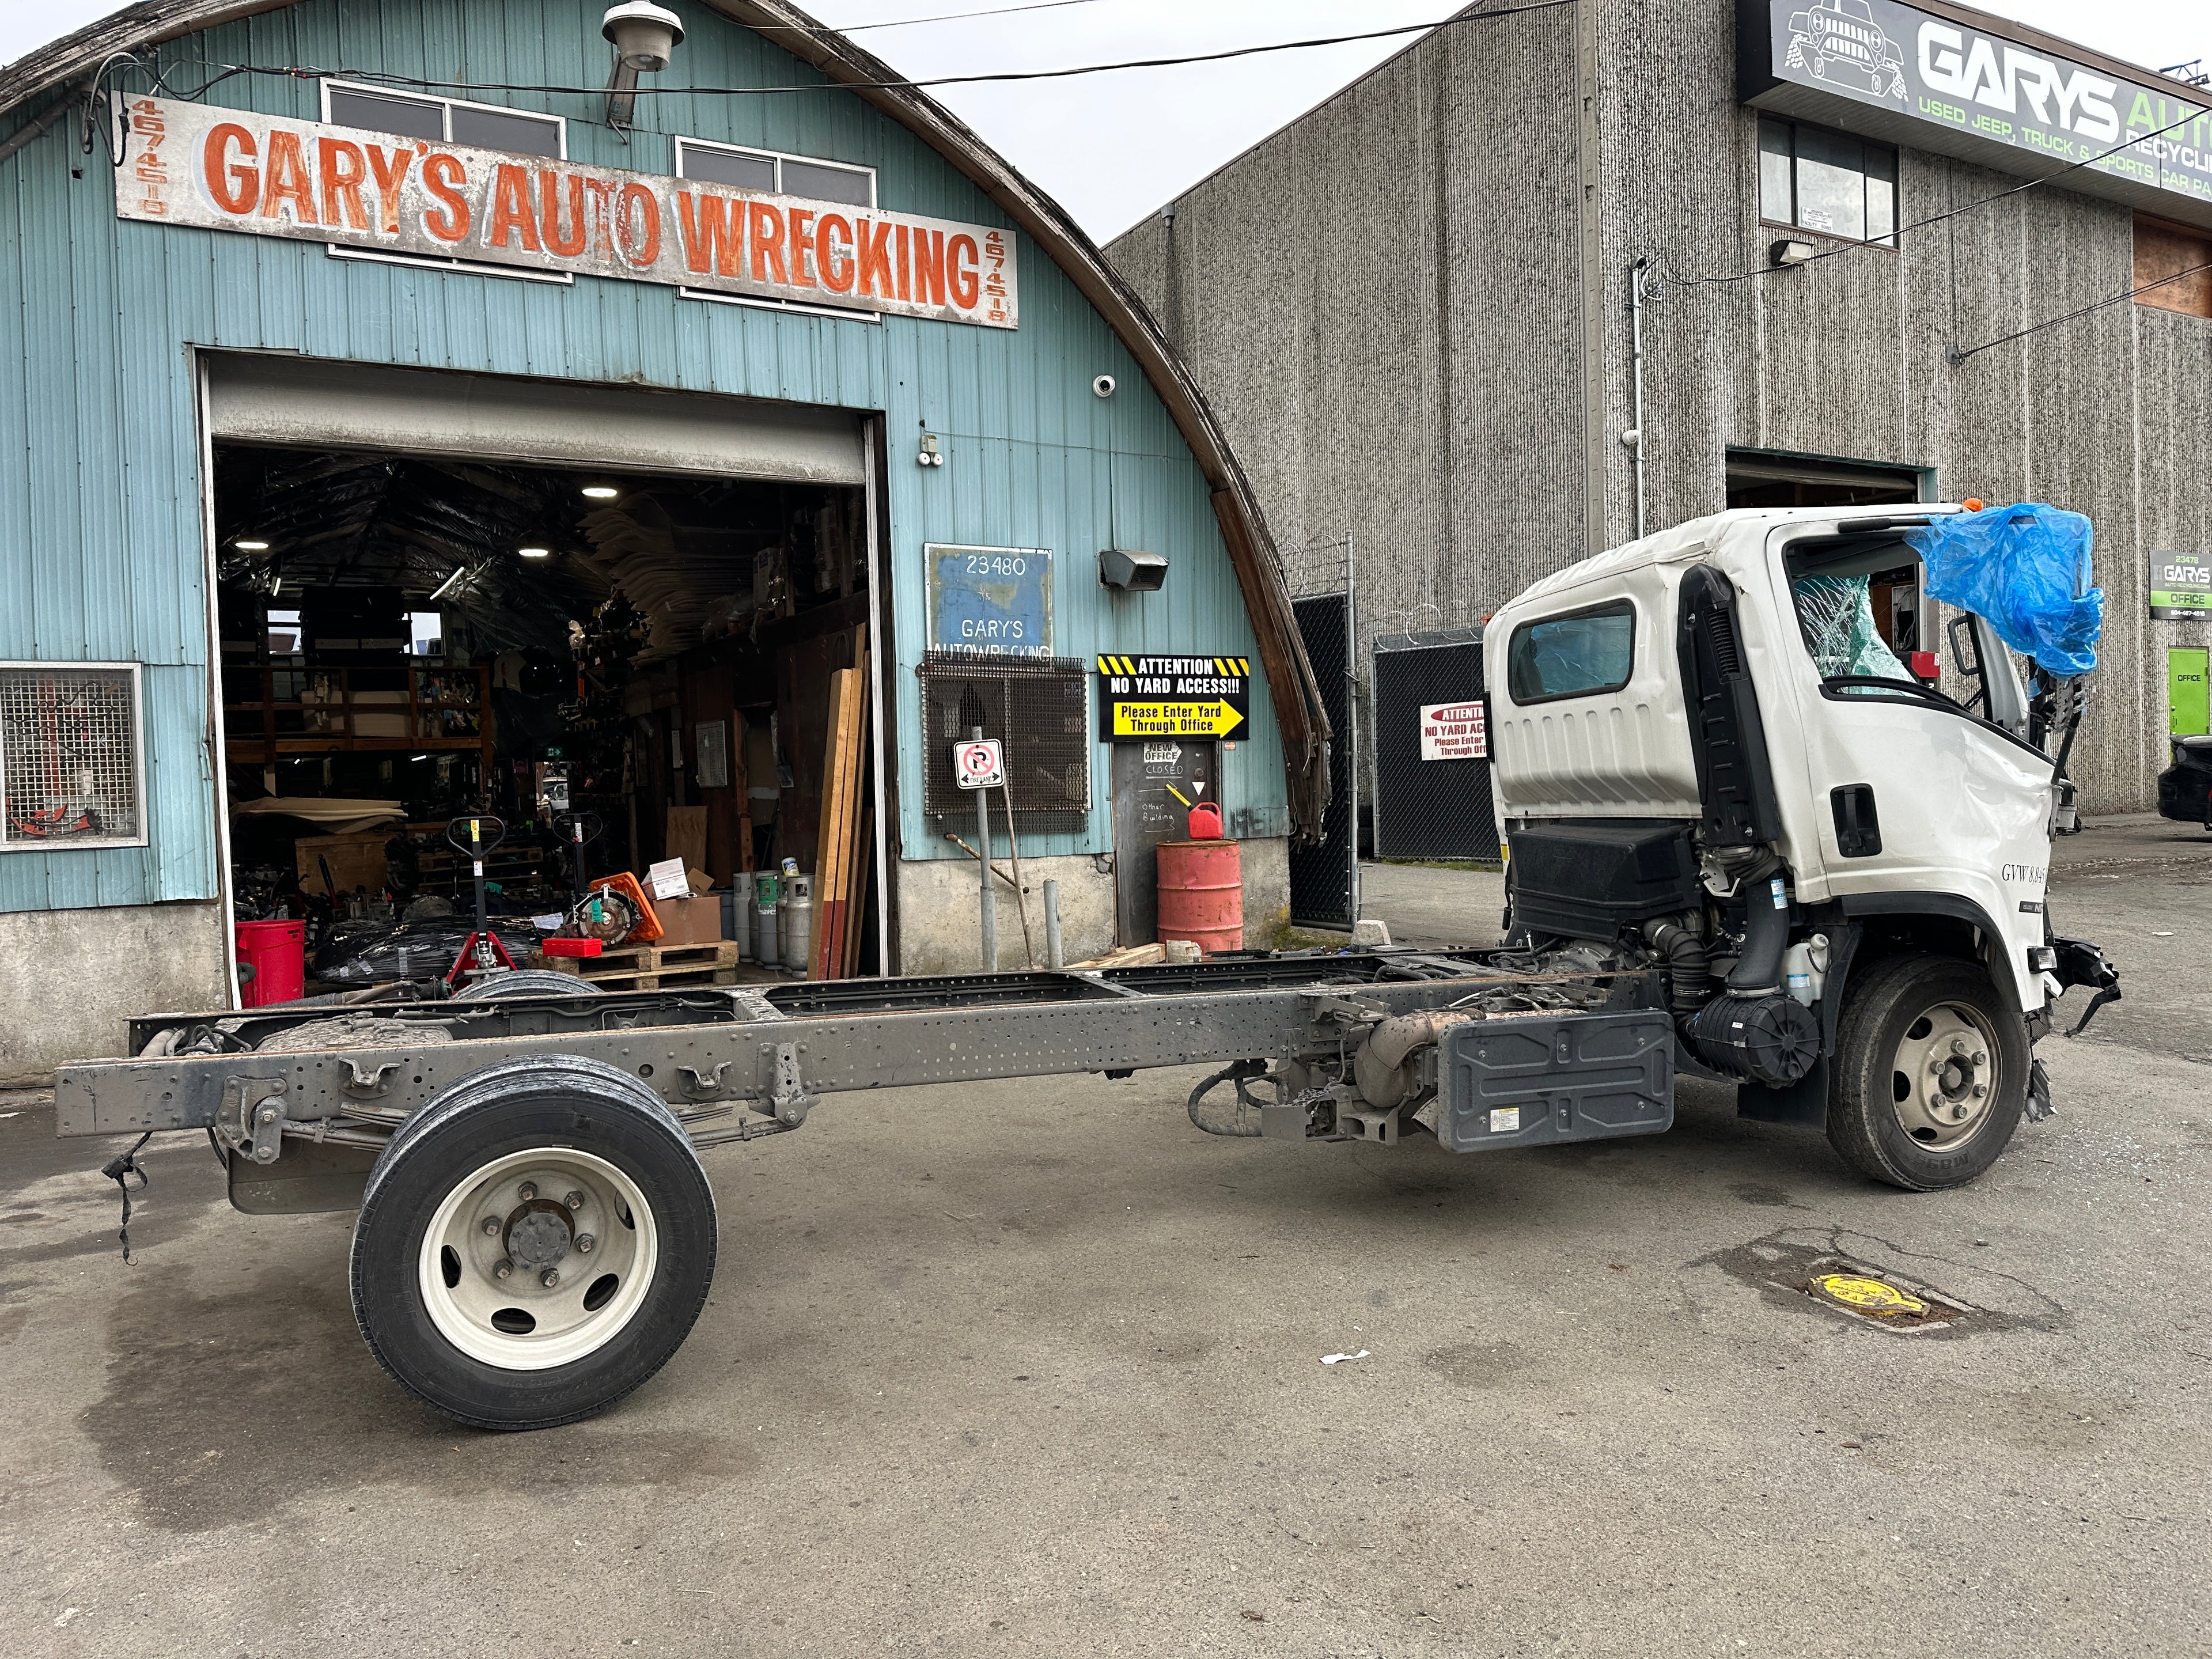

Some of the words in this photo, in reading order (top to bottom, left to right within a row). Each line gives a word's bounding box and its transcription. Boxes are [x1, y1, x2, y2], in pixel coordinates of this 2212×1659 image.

[1918, 21, 2119, 143] GARYS
[2126, 91, 2212, 148] AUT
[1918, 96, 1965, 124] USED
[1971, 113, 2016, 143] JEEP,
[2021, 126, 2074, 156] TRUCK
[2079, 145, 2092, 160] &
[2096, 149, 2154, 179] SPORTS
[2161, 168, 2189, 189] CAR
[2126, 129, 2212, 173] RECYCLI
[199, 122, 471, 243] GARY'S
[490, 164, 660, 267] AUTO
[677, 191, 979, 310] WRECKING
[967, 555, 1026, 575] 23480
[2164, 565, 2210, 584] GARYS
[2171, 593, 2205, 604] OFFICE
[961, 619, 1024, 638] GARY'S
[1138, 658, 1213, 675] ATTENTION
[1111, 677, 1130, 693] NO
[1135, 677, 1171, 694] YARD
[1176, 678, 1239, 694] ACCESS!!!
[1122, 706, 1158, 717] Please
[1164, 706, 1192, 717] Enter
[1198, 705, 1221, 717] Yard
[1442, 707, 1484, 720] ATTENTI
[1130, 719, 1175, 733] Through
[1180, 719, 1213, 731] Office
[1425, 726, 1437, 737] NO
[1441, 724, 1467, 736] YARD
[1148, 743, 1173, 752] NEW
[1434, 738, 1459, 746] Please
[1461, 736, 1483, 745] Enter
[1145, 752, 1178, 760] OFFICE
[1440, 746, 1472, 756] Through
[1146, 765, 1183, 774] CLOSED
[1143, 812, 1175, 824] Building
[2002, 863, 2029, 882] GVW
